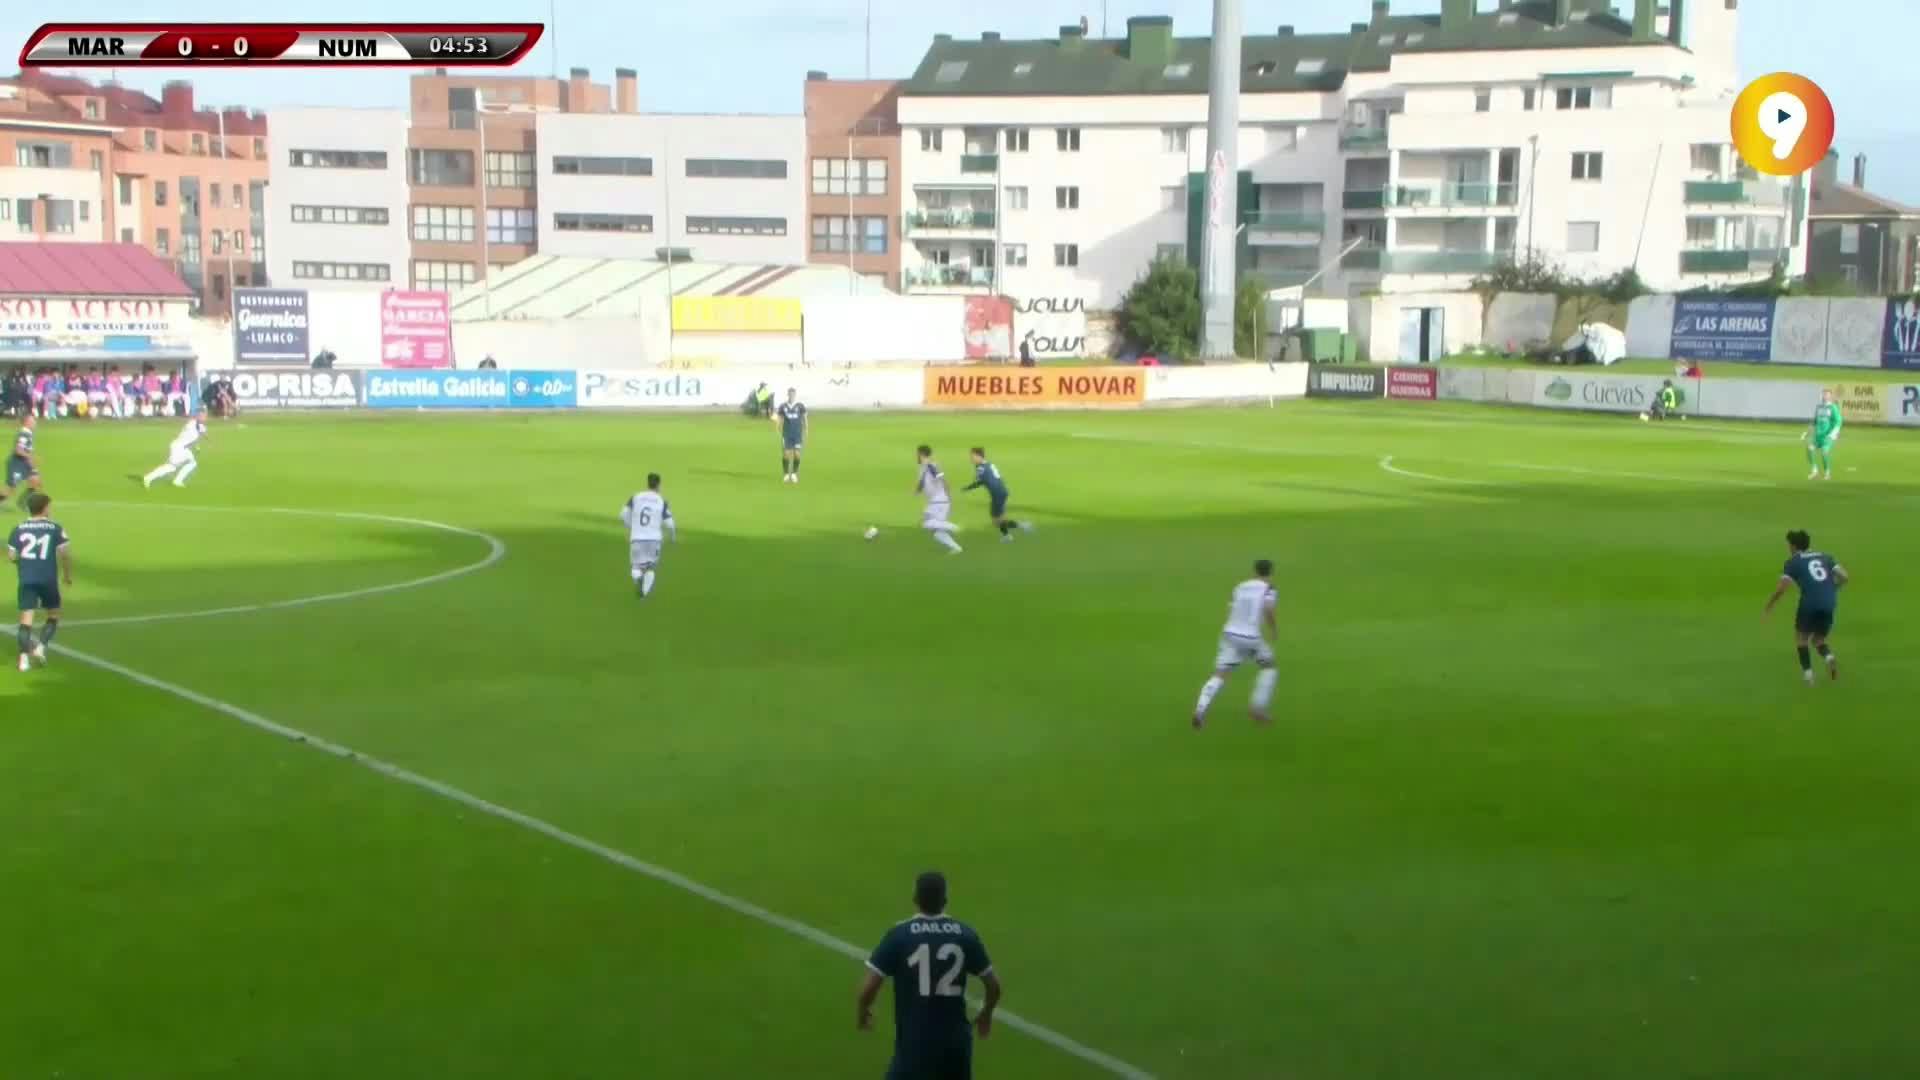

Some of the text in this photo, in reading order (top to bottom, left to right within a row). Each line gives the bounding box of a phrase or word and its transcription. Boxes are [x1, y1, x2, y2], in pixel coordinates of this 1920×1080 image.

[240, 295, 304, 307] RESTAURANTE
[238, 308, 307, 331] Guernica
[1695, 316, 1768, 333] LAS ARENAS
[369, 376, 506, 399] Estrella Galicia
[937, 375, 1137, 397] MUEBLES NOVAR
[1320, 371, 1375, 393] IMPULSO27
[639, 506, 651, 527] 6
[18, 533, 51, 561] 21
[1807, 559, 1828, 582] 6
[906, 943, 966, 997] 12
